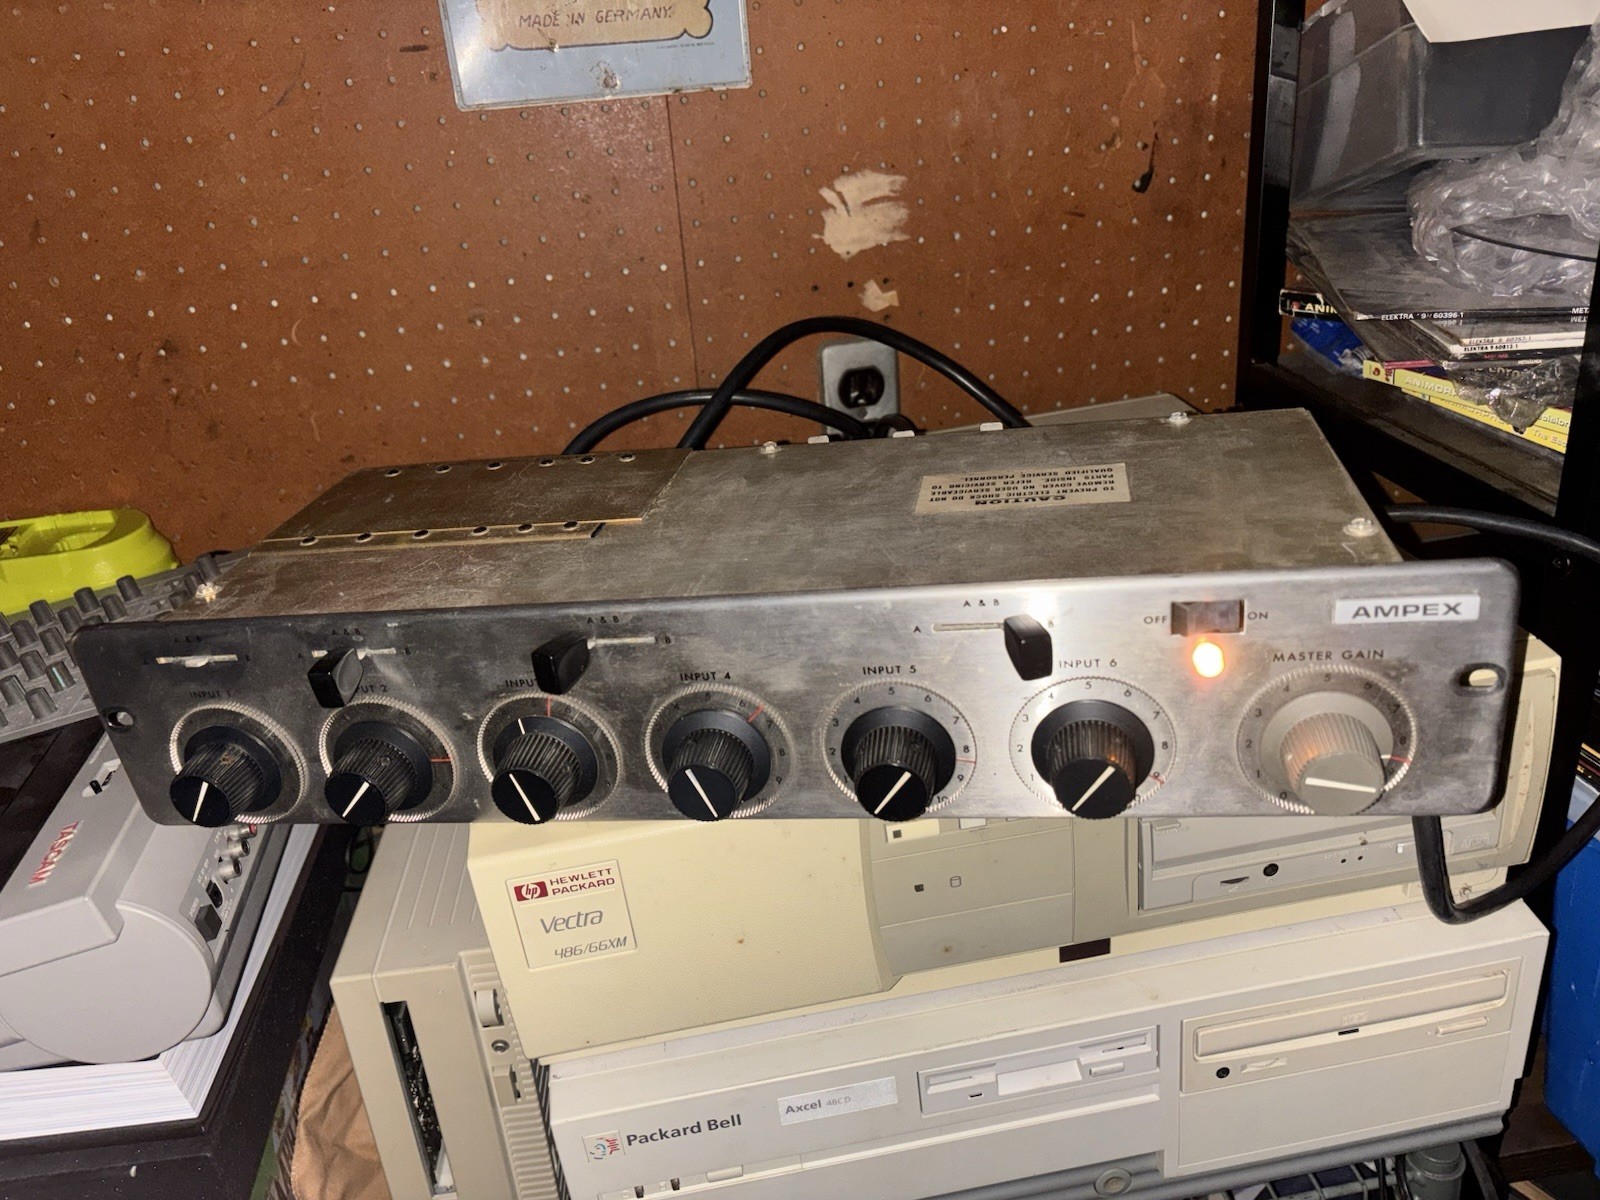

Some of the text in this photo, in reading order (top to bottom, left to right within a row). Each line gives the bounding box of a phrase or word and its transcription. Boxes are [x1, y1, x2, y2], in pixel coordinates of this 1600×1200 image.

[518, 13, 560, 28] MADE
[1381, 313, 1414, 321] ELEKTRA
[1065, 467, 1113, 475] QUALIFIED
[931, 487, 991, 496] SERVICEABLE
[975, 495, 1066, 505] CAUTION
[963, 599, 972, 607] A
[1351, 602, 1463, 619] AMPEX
[1143, 615, 1168, 625] OFF
[1247, 611, 1269, 620] ON
[913, 626, 922, 634] A
[1272, 649, 1385, 662] MASTER GAIN
[1059, 659, 1118, 668] INPUT 6
[863, 664, 917, 676] INPUT 5
[680, 671, 731, 682] INPUT 4
[1323, 673, 1331, 683] 5
[381, 684, 388, 693] 2
[1084, 680, 1092, 689] 5
[1283, 685, 1290, 693] 4
[189, 690, 221, 699] INPUT
[888, 687, 895, 696] 5
[1123, 688, 1132, 697] 6
[854, 696, 861, 704] 4
[924, 694, 932, 703] 6
[739, 700, 746, 708] 6
[1022, 713, 1029, 722] 3
[1152, 711, 1160, 720] 7
[1254, 708, 1262, 718] 3
[832, 718, 839, 727] 3
[953, 716, 960, 725] 7
[1161, 741, 1169, 750] 8
[1245, 739, 1252, 749] 2
[1400, 736, 1407, 746] 8
[779, 748, 786, 757] 8
[829, 747, 836, 756] 2
[963, 745, 970, 754] 8
[1016, 743, 1024, 753] 2
[957, 773, 964, 782] 9
[1153, 771, 1160, 780] 9
[775, 776, 782, 785] 9
[1279, 791, 1288, 800] 0
[29, 820, 81, 887] TASCAM
[550, 868, 612, 885] HEWLETT
[524, 882, 539, 900] hp
[552, 878, 615, 895] PACKARD
[540, 910, 603, 934] Vectra
[554, 935, 628, 959] 486/66XM
[785, 1098, 822, 1115] Axcel
[626, 1113, 742, 1147] Packard Bell
